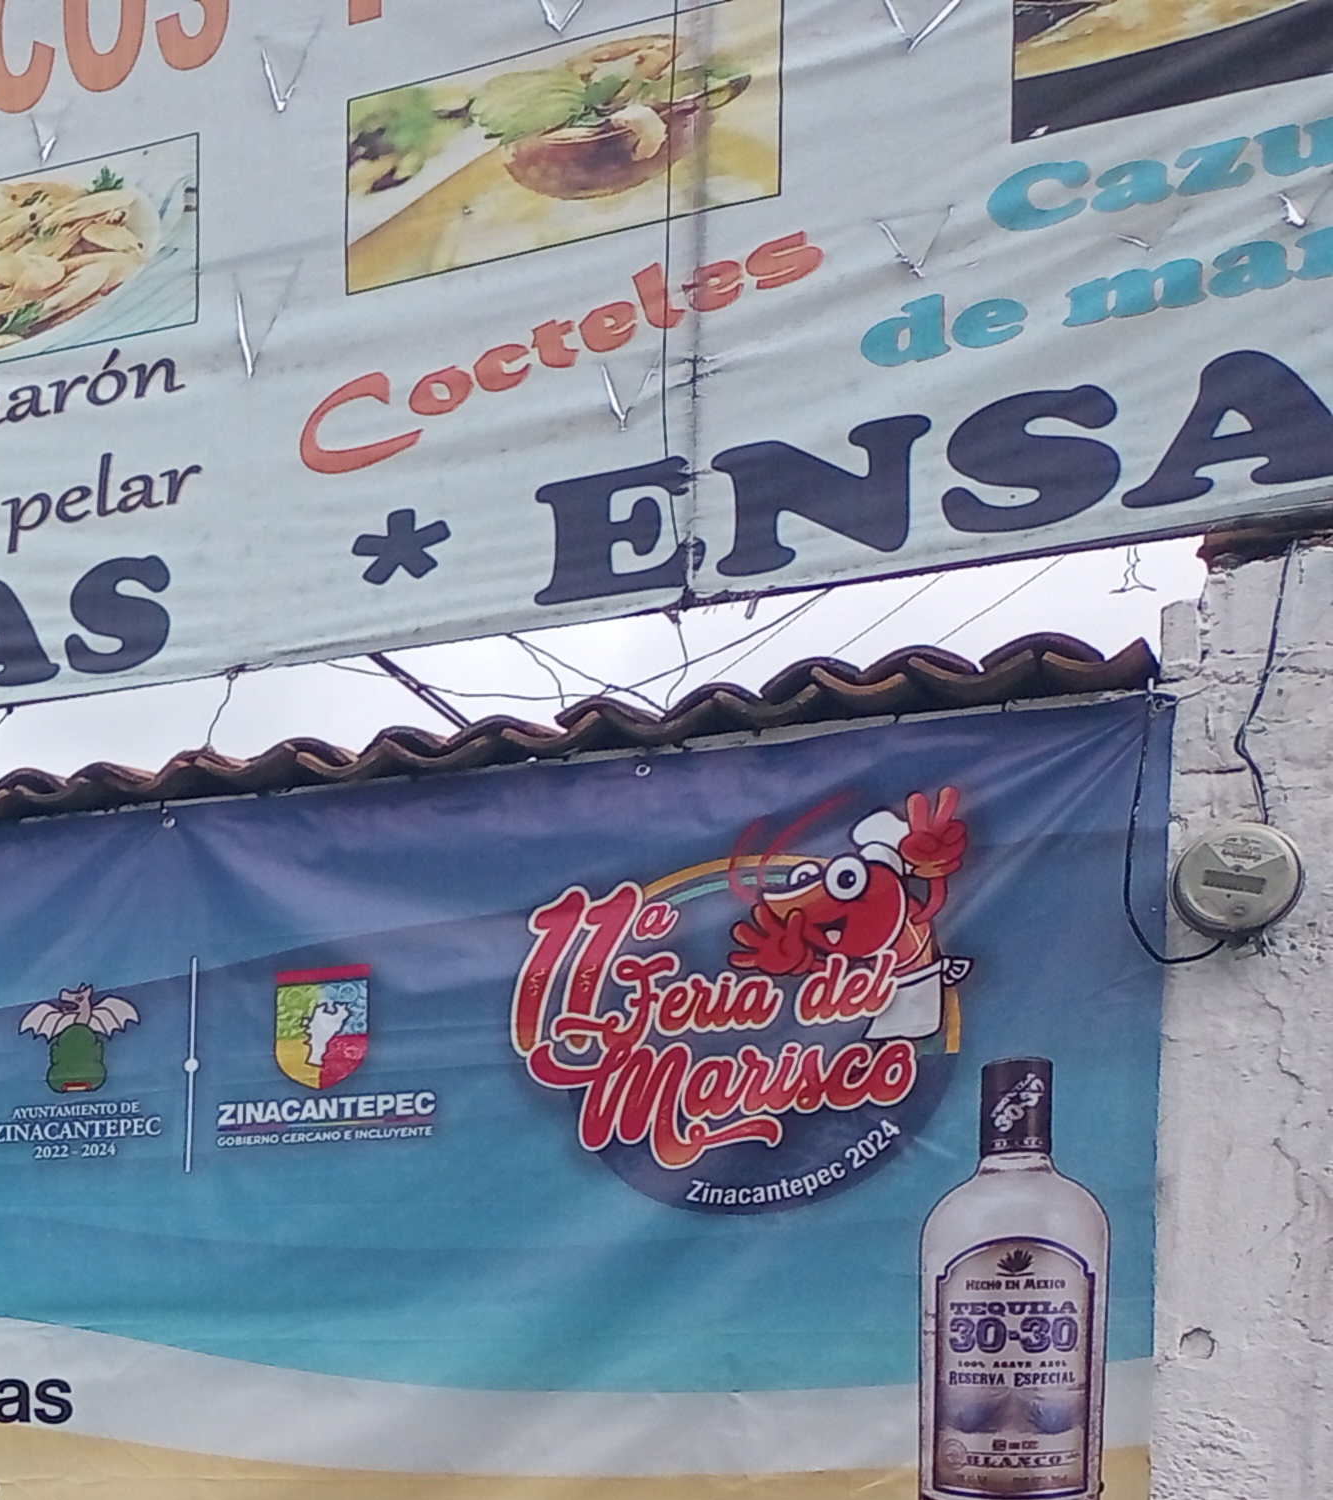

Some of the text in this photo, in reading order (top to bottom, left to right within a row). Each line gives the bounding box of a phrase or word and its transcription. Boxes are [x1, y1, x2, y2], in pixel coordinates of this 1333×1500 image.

[861, 294, 1028, 368] de
[300, 231, 824, 475] Cocteles
[1, 453, 202, 553] pelar
[555, 953, 897, 1048] Feria del
[12, 1101, 140, 1120] AYUNTAMIENTO DE
[217, 1091, 436, 1127] ZINACANTEPEC
[529, 1038, 919, 1168] Marisco
[34, 1143, 116, 1159] 2022 2024
[216, 1126, 433, 1148] GOBIERNO CERCANO E INCLUYENTE
[686, 1117, 902, 1206] Zinacantepec 2024
[949, 1300, 1078, 1317] TEQUILA
[949, 1316, 1079, 1354] 30-30
[949, 1371, 1076, 1388] RESERVA ESPECIAL
